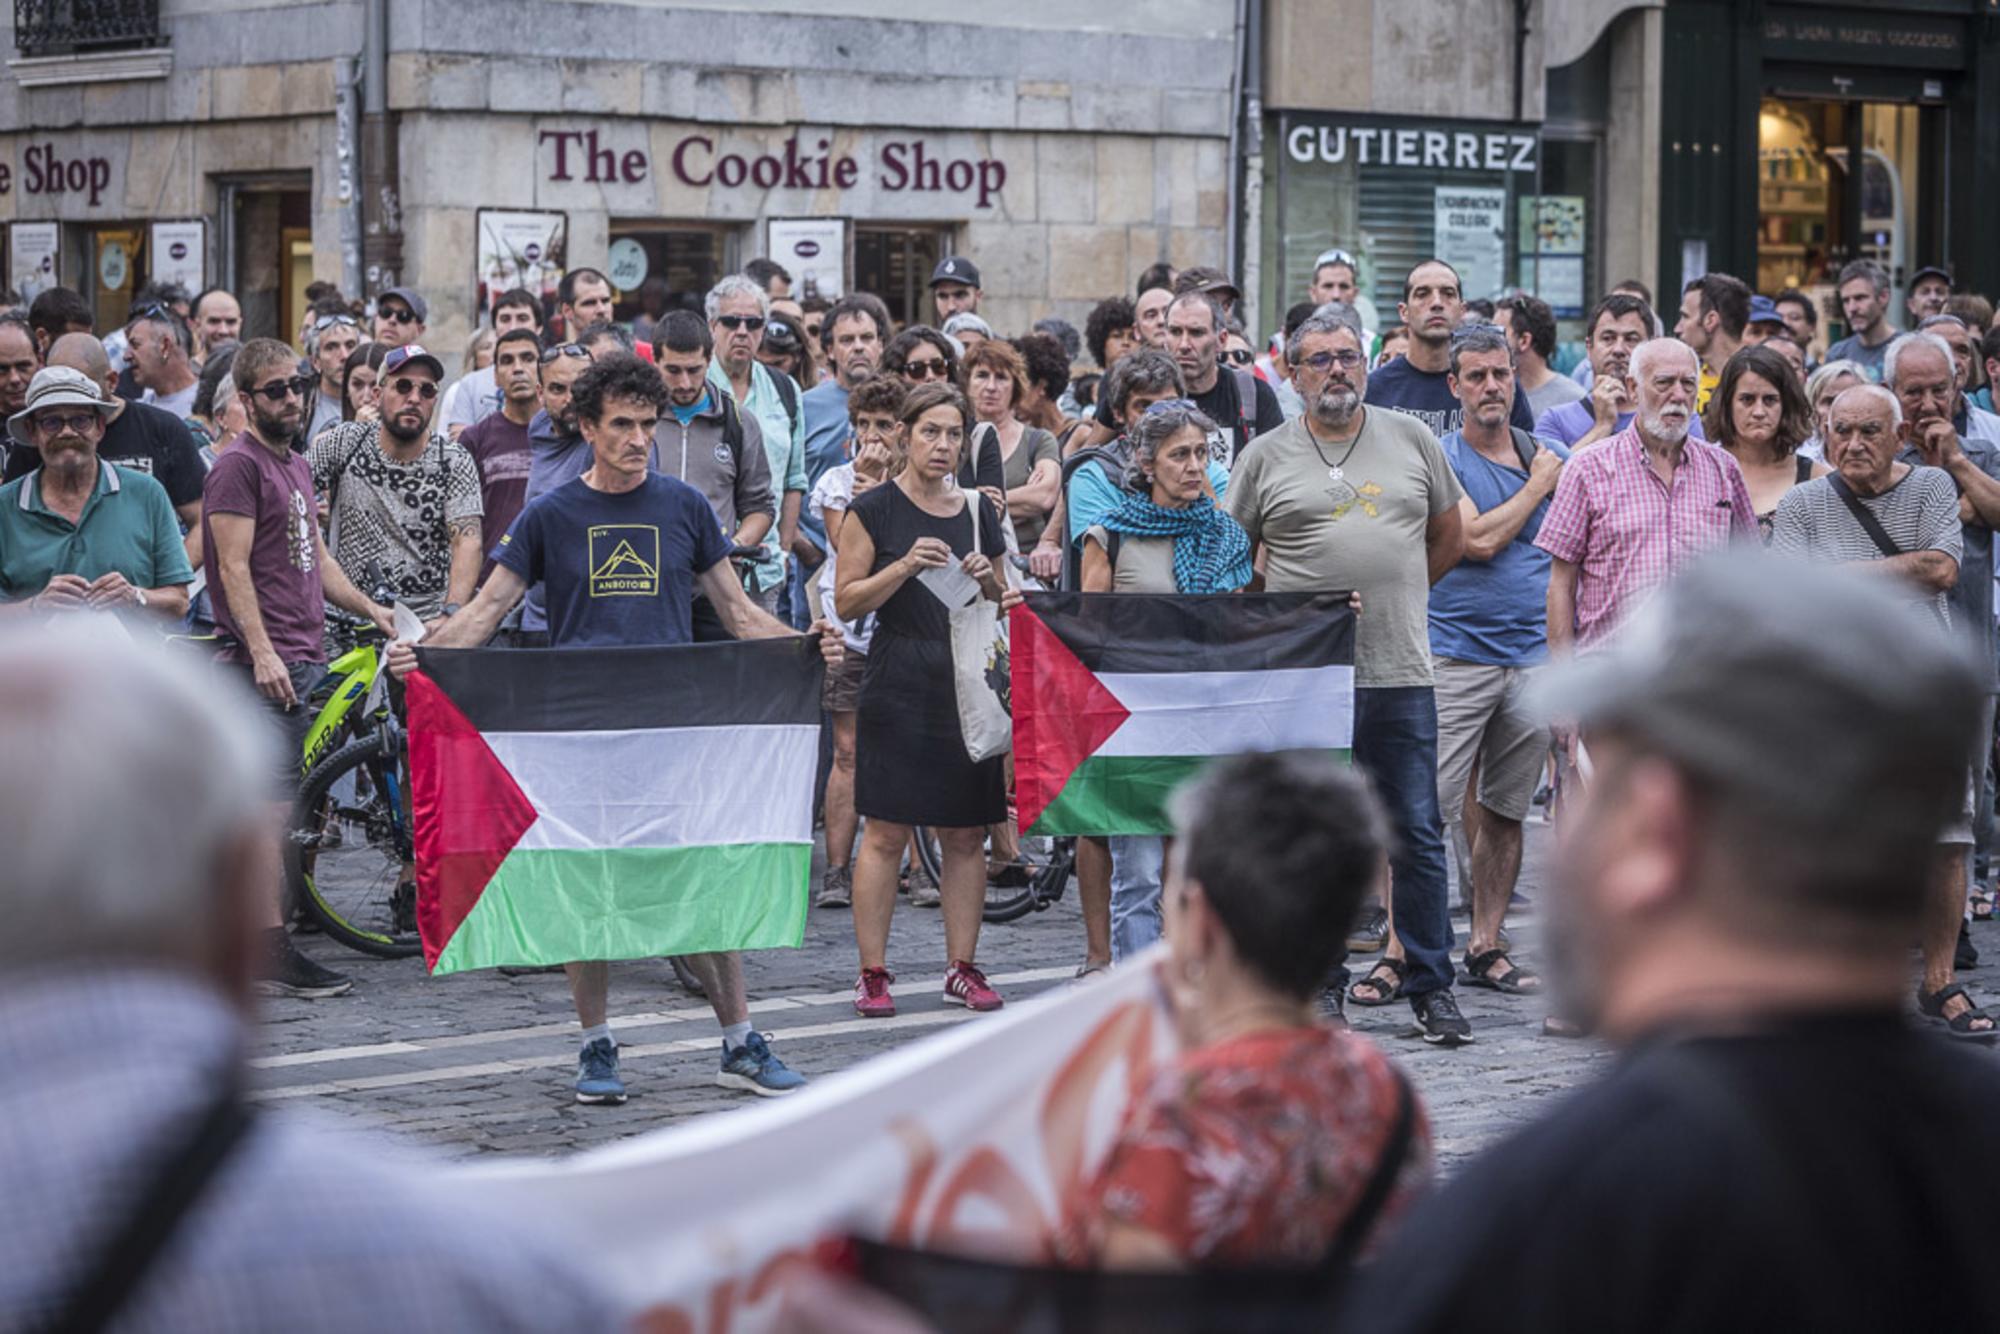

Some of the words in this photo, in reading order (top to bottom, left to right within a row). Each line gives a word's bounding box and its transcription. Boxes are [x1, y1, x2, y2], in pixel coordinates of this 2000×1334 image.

[24, 142, 111, 207] Shop
[538, 128, 648, 185] The
[671, 134, 858, 190] Cookie
[880, 140, 1007, 209] Shop
[1287, 125, 1536, 172] GUTIERREZ
